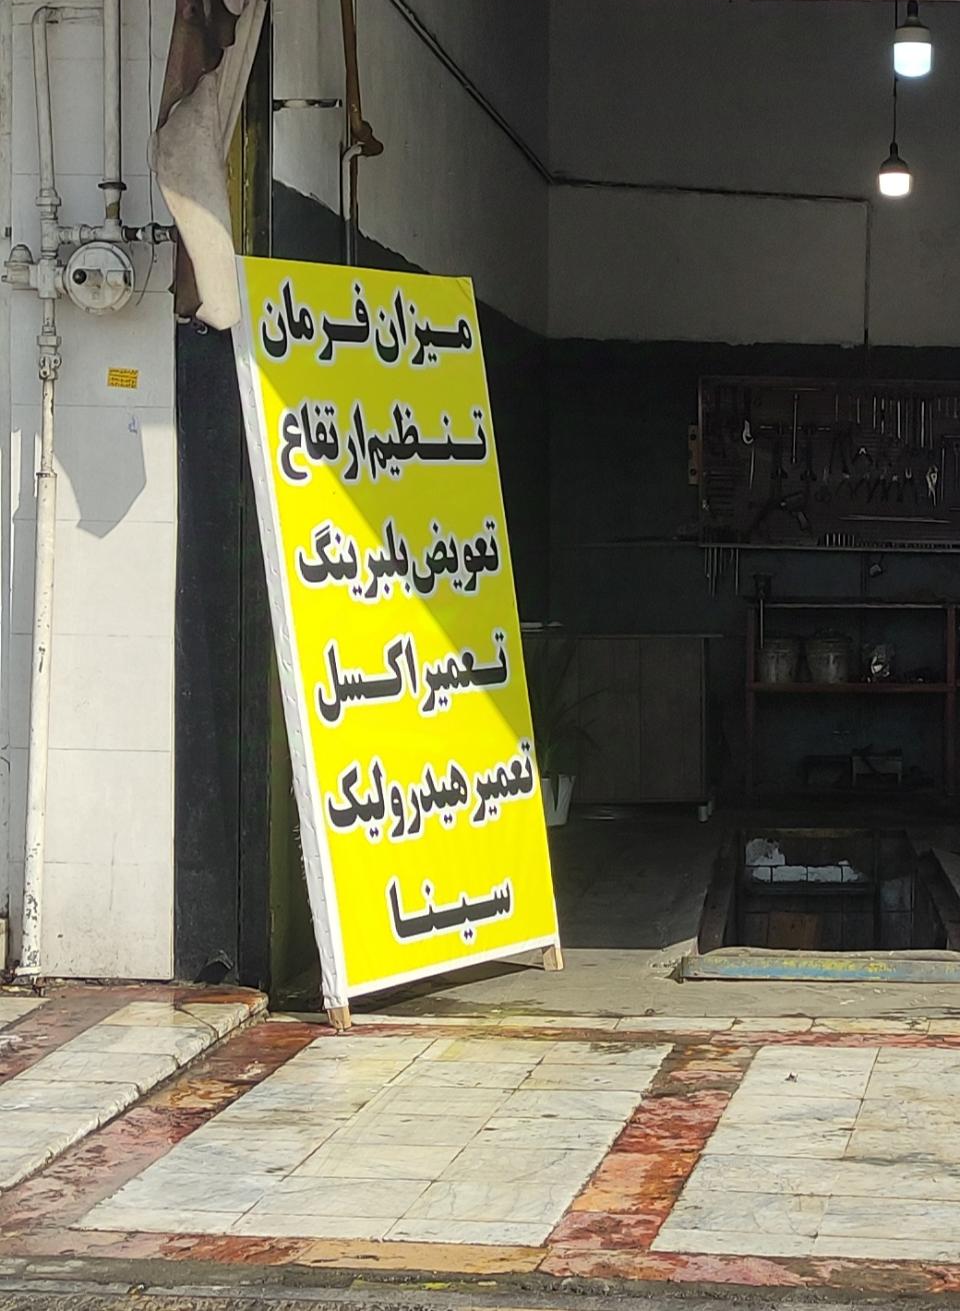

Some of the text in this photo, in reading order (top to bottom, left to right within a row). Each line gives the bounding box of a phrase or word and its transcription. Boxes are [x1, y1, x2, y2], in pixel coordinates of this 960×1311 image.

[262, 281, 473, 365] میزان فرمان
[280, 402, 488, 480] تنظیم ارتفاع
[299, 520, 500, 598] تعویض بلبرینگ
[318, 632, 508, 722] تعمیر اکسل
[328, 740, 534, 838] تعمیر هیدرولیک
[389, 880, 512, 939] سینا
